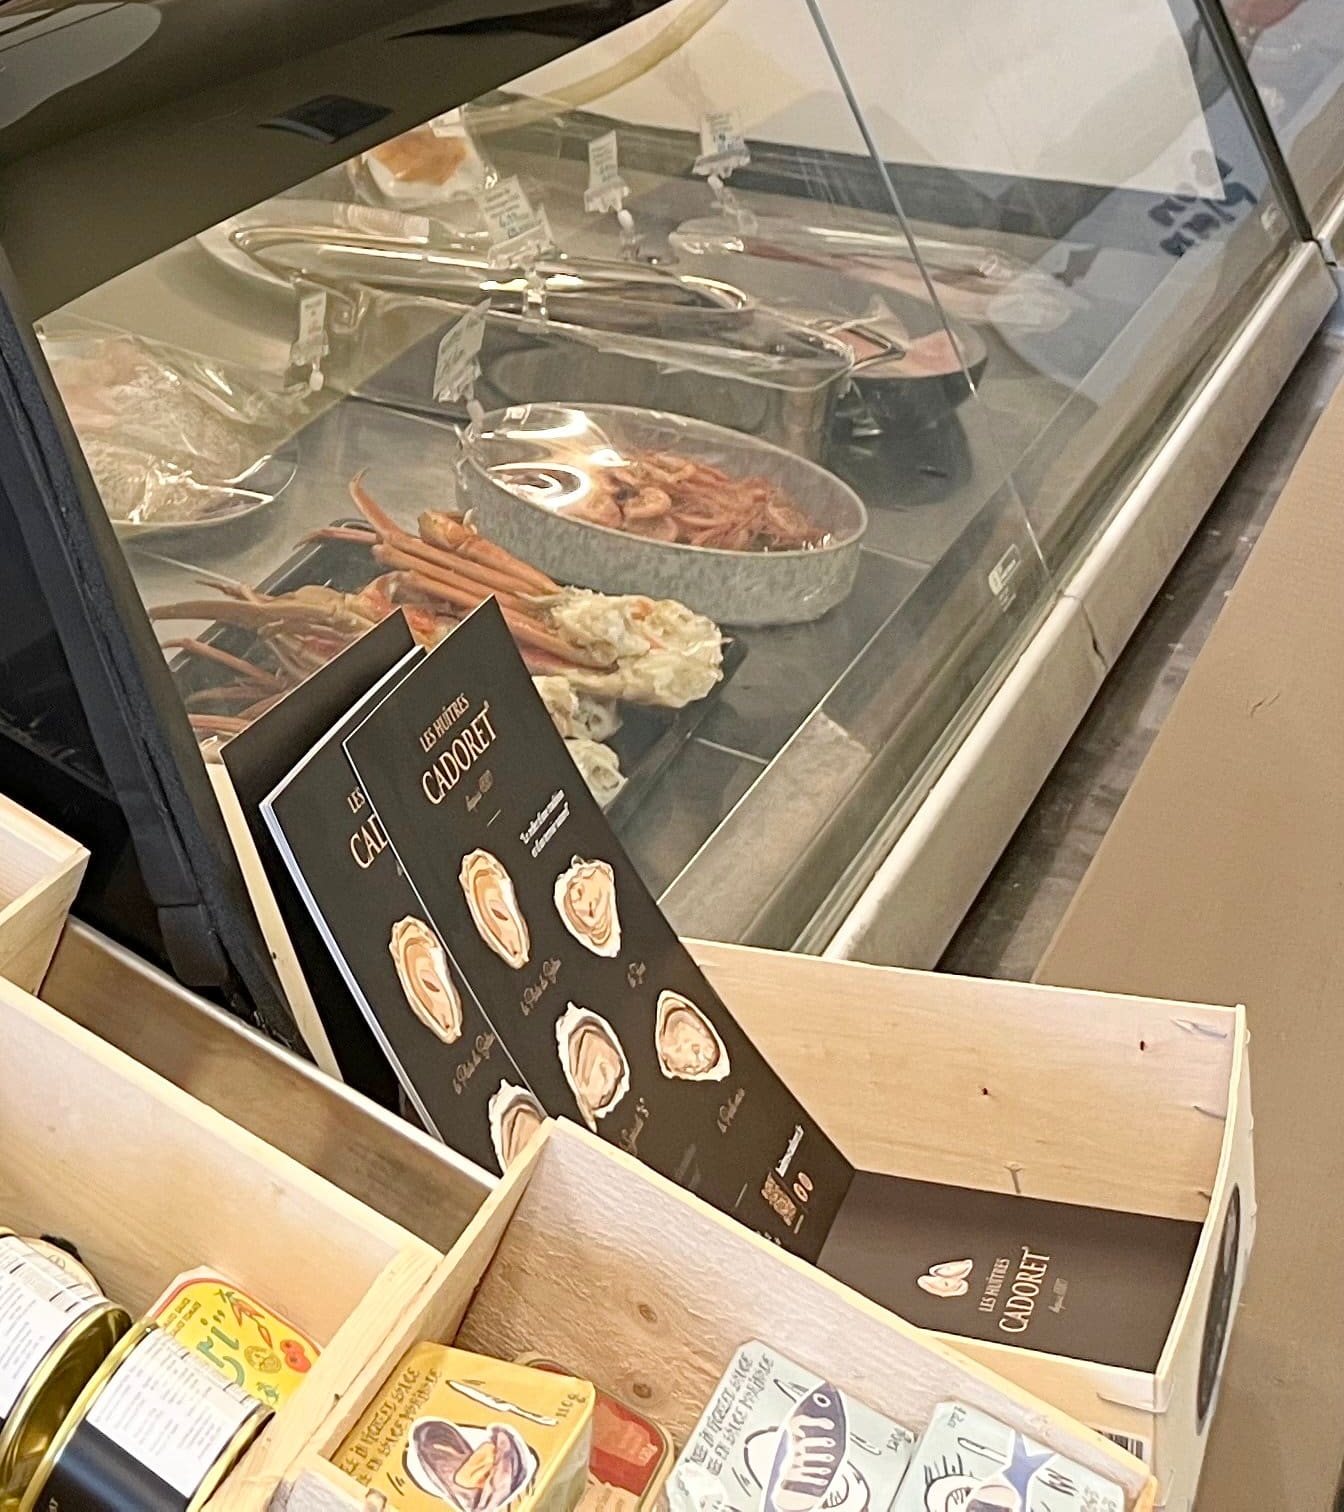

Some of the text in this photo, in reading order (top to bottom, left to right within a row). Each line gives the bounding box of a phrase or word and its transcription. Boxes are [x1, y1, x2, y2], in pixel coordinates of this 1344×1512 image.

[418, 725, 438, 754] LES
[421, 699, 497, 806] CADORET
[998, 1245, 1051, 1333] CADORET
